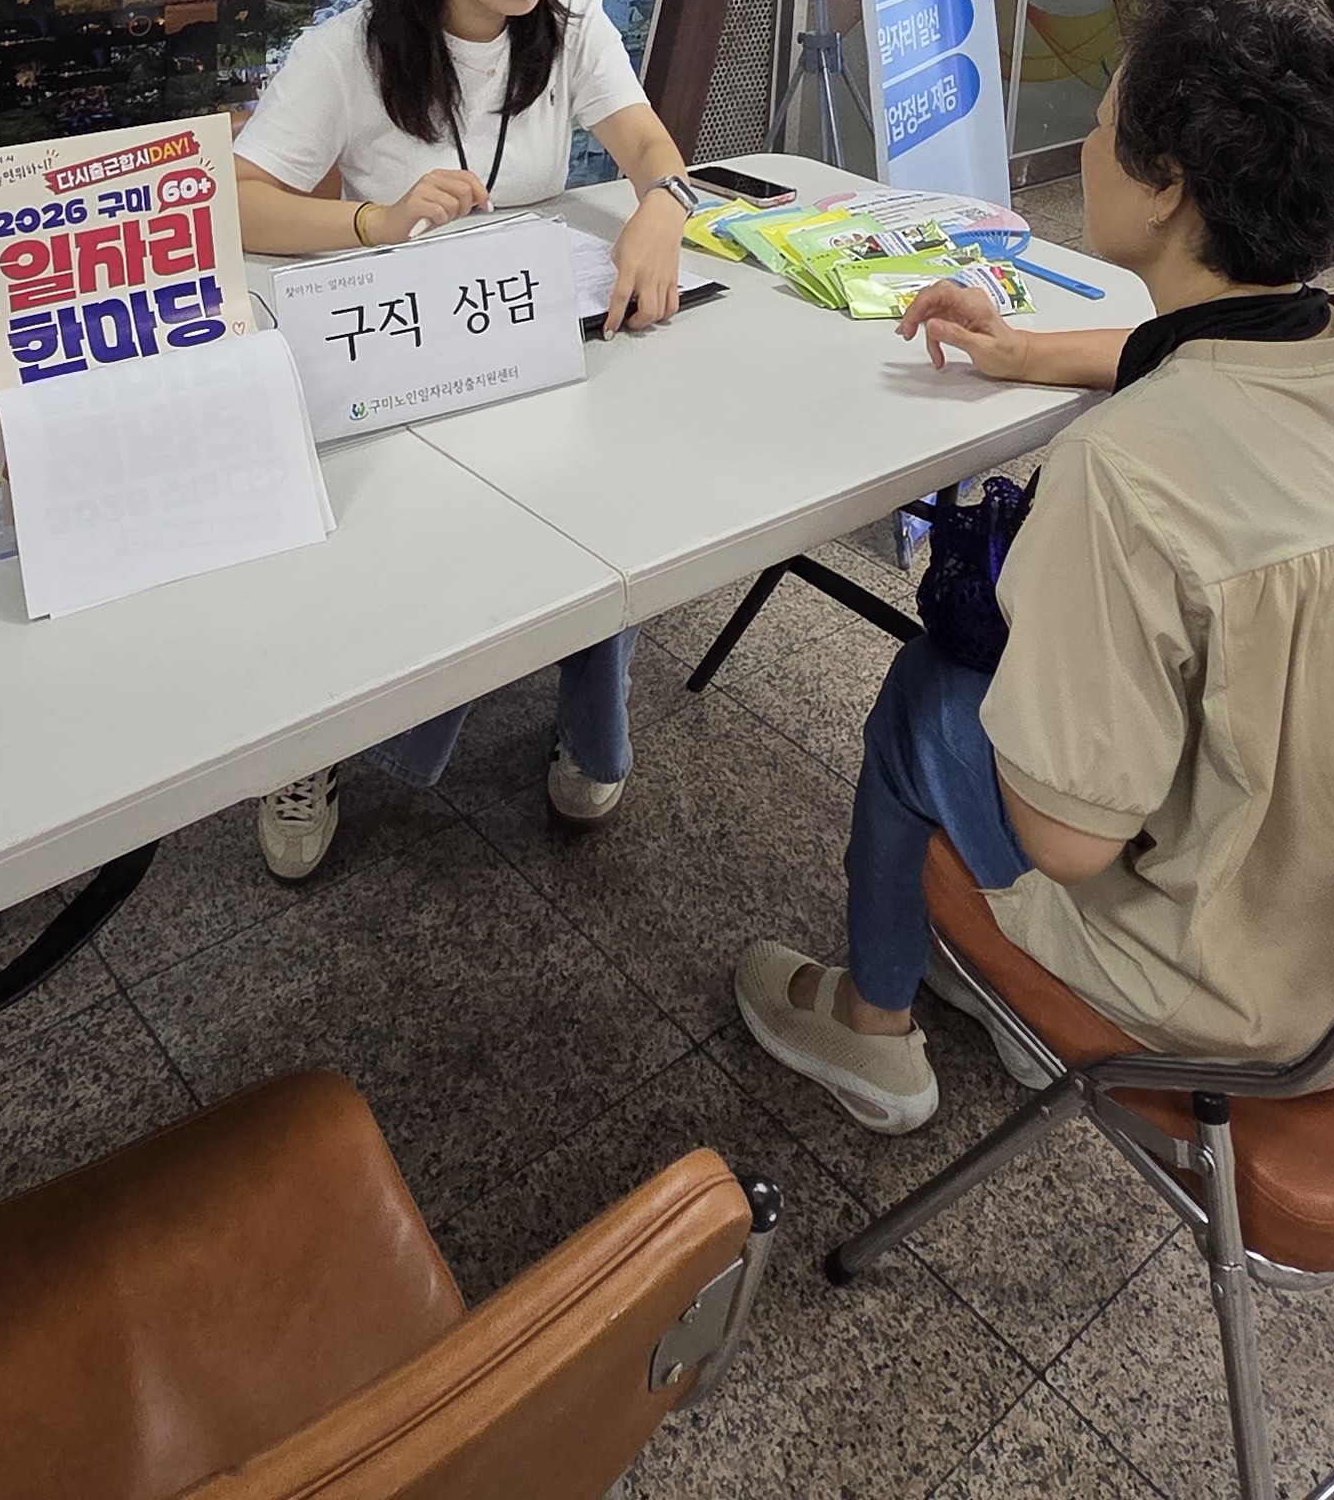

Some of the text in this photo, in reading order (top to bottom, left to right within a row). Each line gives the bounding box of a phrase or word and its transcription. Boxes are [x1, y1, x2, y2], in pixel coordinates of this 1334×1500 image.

[877, 4, 941, 66] 일자리 알선
[931, 74, 958, 115] 제공
[97, 185, 152, 218] 구미
[161, 177, 212, 203] 60+
[7, 274, 227, 385] 한마당
[325, 269, 540, 362] 구직 상담
